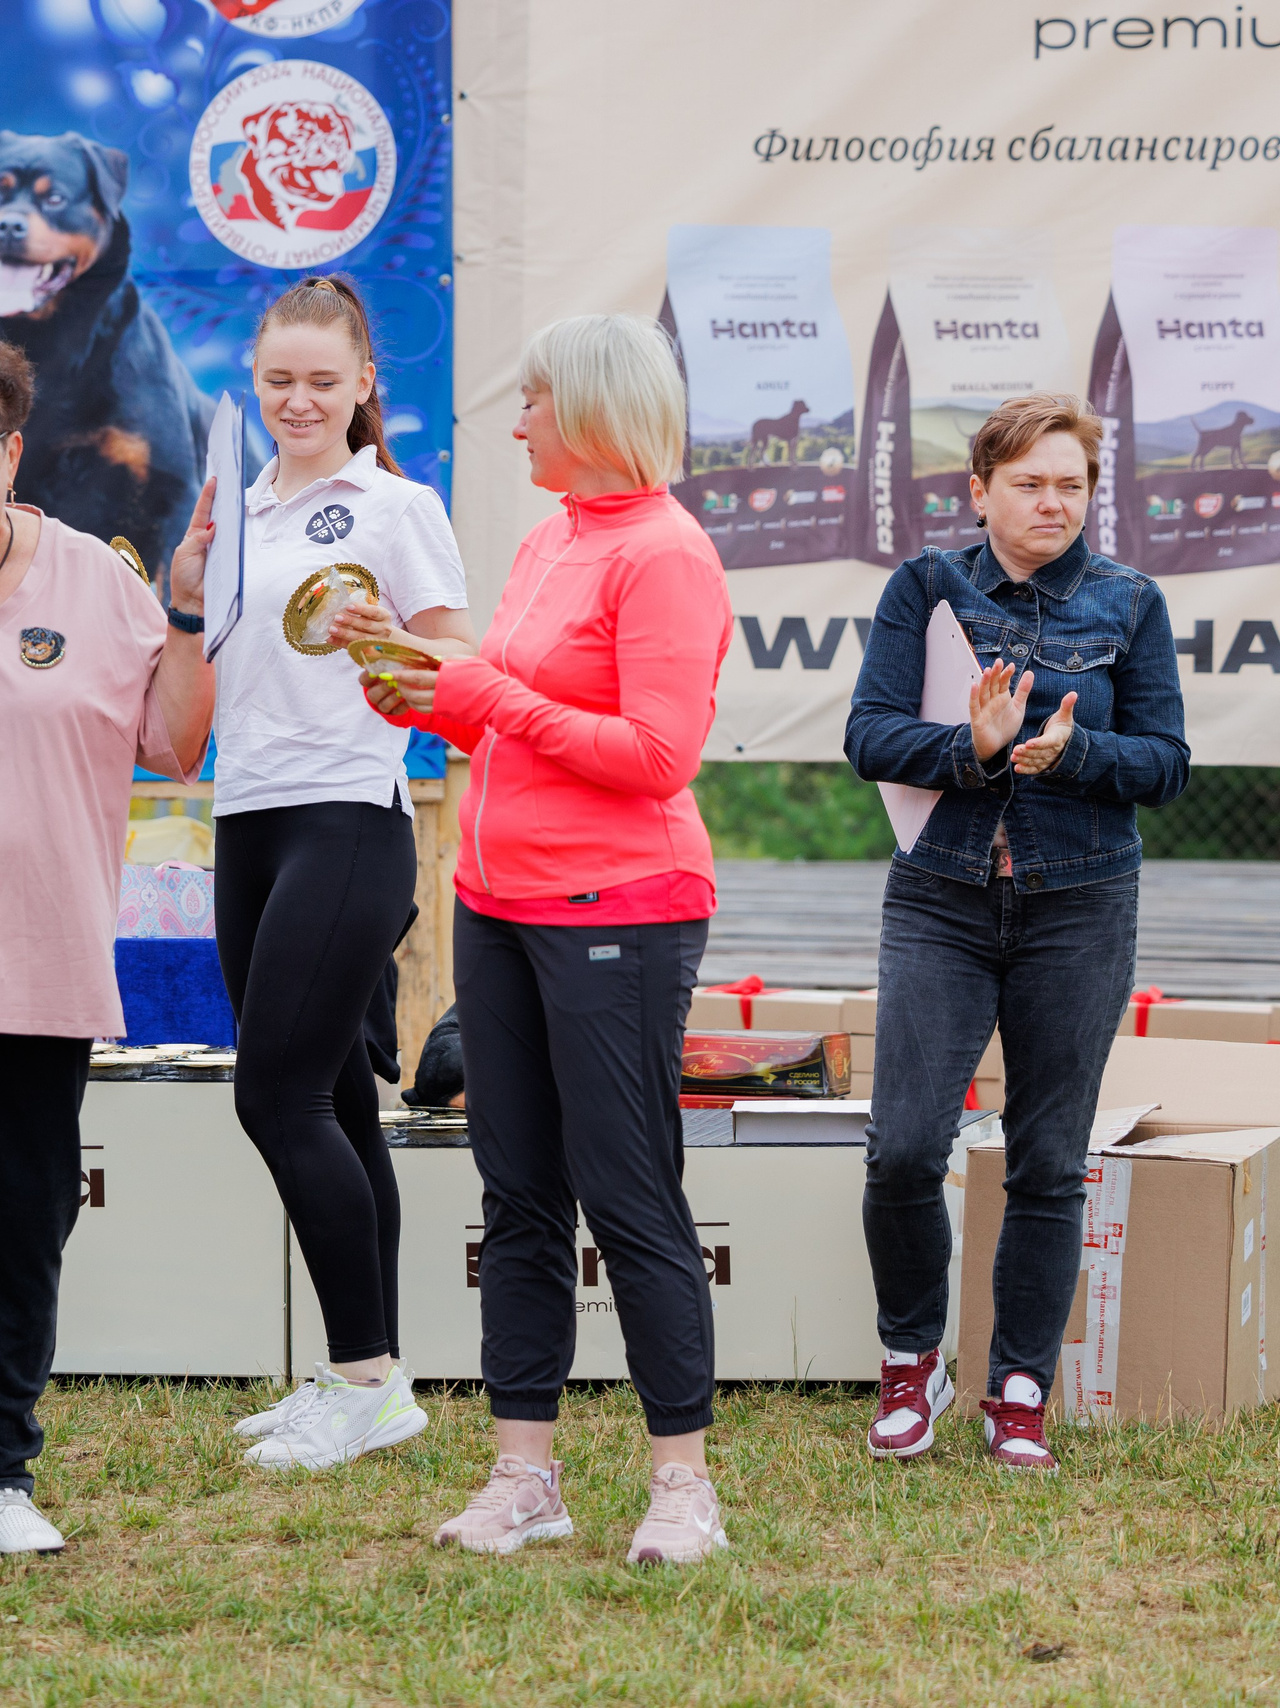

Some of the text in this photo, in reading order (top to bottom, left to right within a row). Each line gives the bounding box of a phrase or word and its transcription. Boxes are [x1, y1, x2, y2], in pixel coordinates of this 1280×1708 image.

[246, 63, 291, 89] 2024
[753, 126, 995, 171] Философия
[710, 319, 818, 339] Hanta
[934, 319, 1040, 340] Hanta
[1157, 318, 1264, 339] Hanta
[875, 420, 896, 555] Hanta
